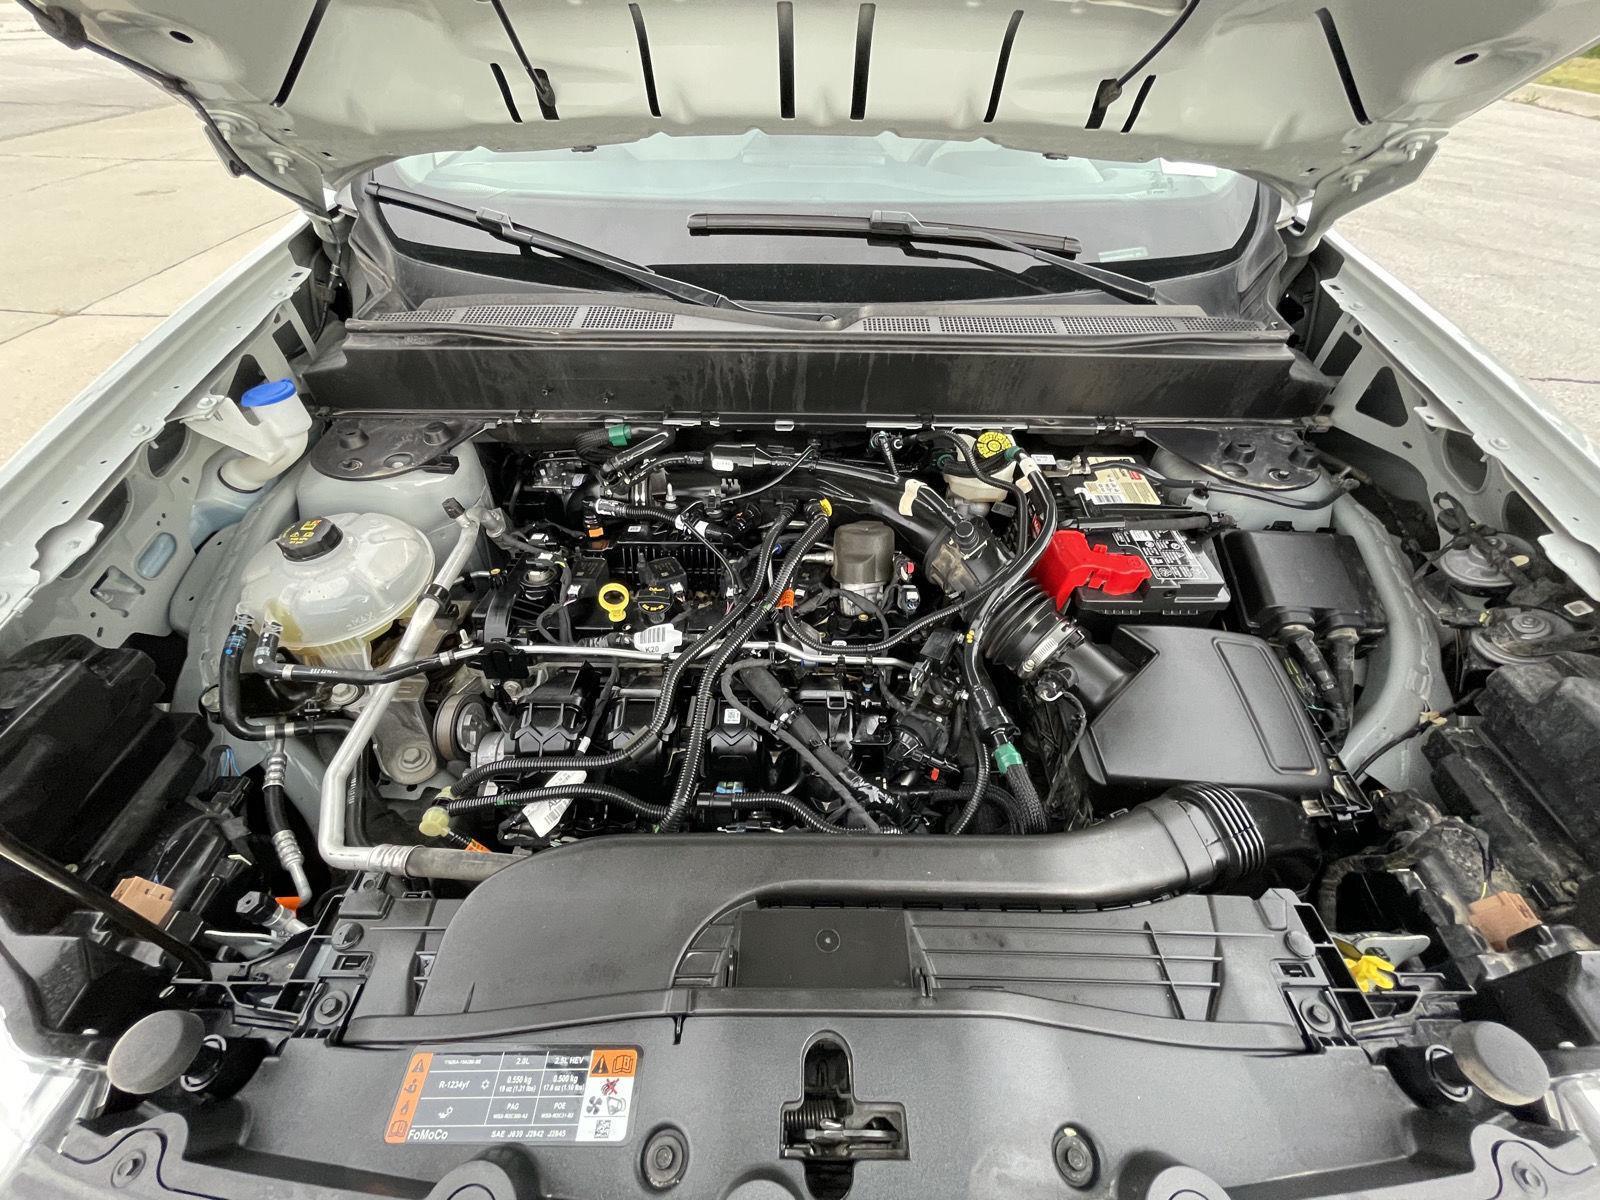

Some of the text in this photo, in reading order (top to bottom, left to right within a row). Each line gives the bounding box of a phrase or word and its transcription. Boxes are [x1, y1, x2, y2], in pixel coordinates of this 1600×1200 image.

[645, 646, 660, 654] K20
[516, 1057, 530, 1065] 2.0L
[554, 1056, 585, 1065] 2.5L HEV
[524, 1075, 532, 1085] kg
[569, 1075, 579, 1084] kg
[438, 1080, 471, 1089] R-1234yf
[506, 1102, 520, 1110] PAG
[553, 1102, 567, 1110] POE
[407, 1128, 449, 1140] FoMoCo
[490, 1130, 506, 1138] SAE
